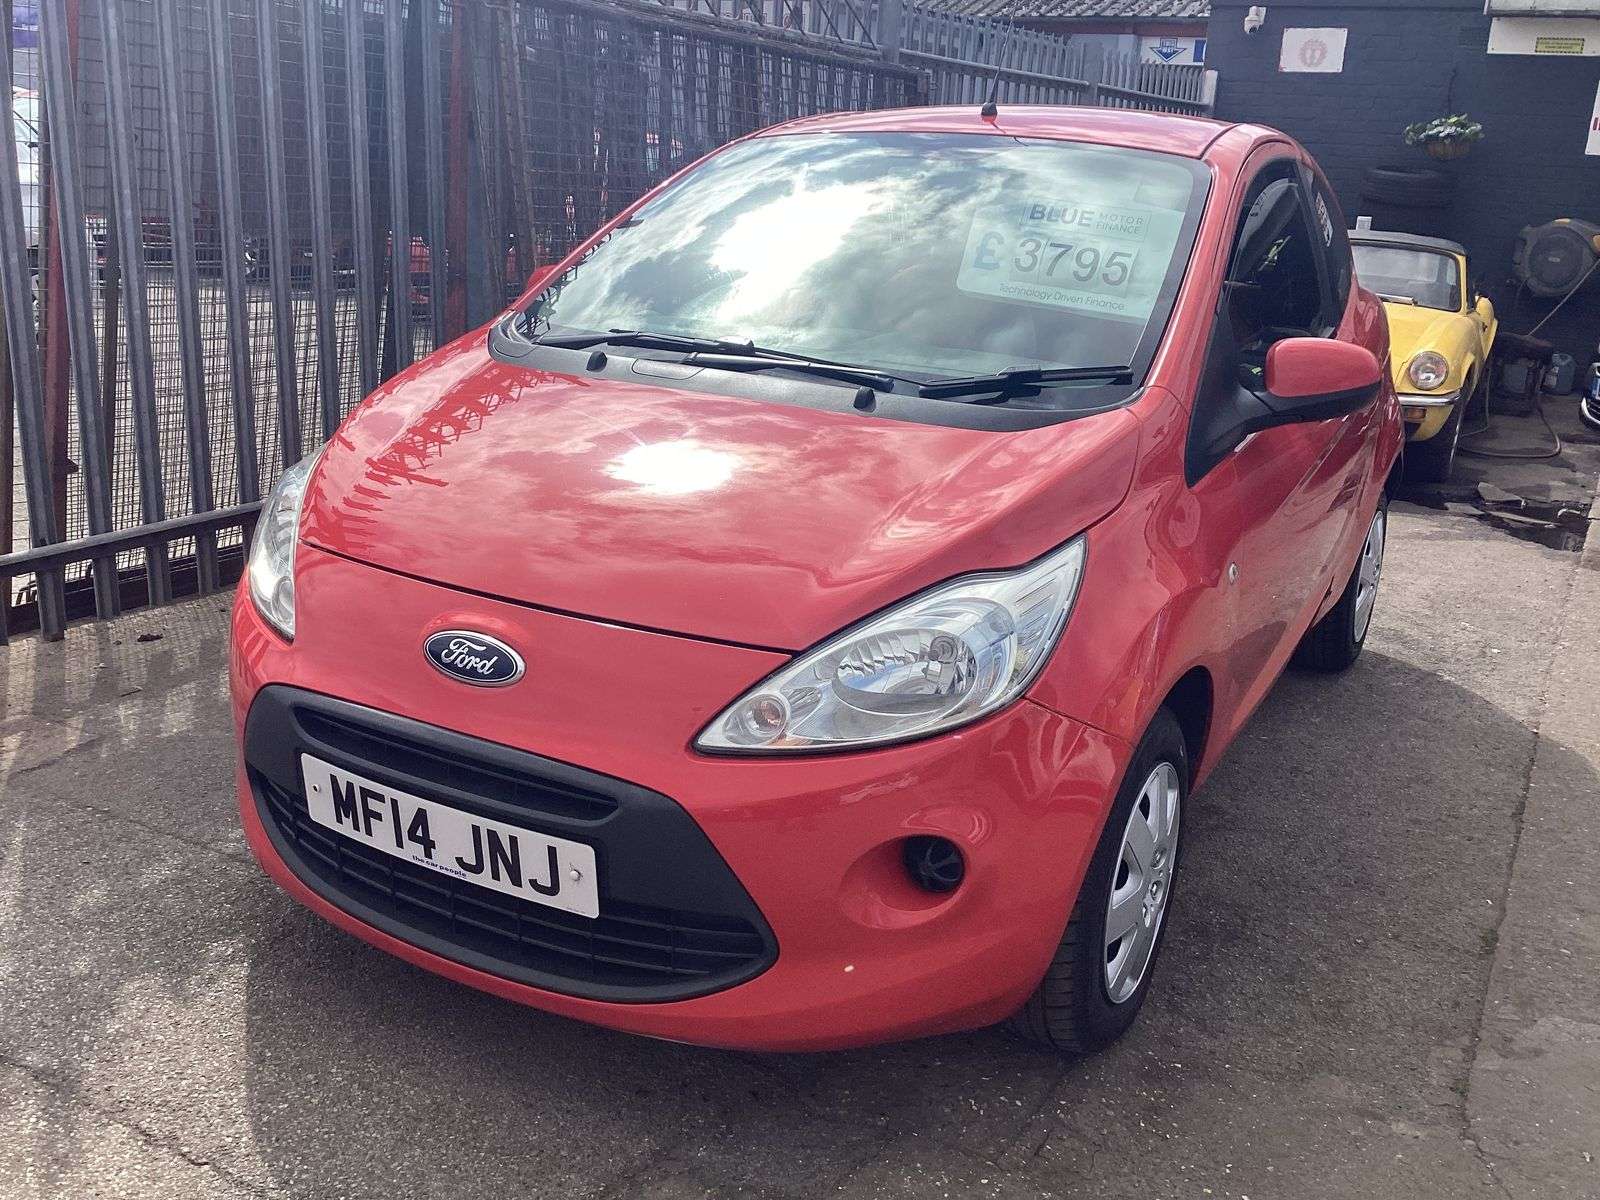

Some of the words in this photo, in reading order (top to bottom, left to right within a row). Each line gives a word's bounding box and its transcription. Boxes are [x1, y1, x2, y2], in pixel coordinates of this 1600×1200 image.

[1029, 203, 1095, 227] BLUE
[1096, 221, 1142, 235] FINANCE
[1099, 212, 1144, 226] MOTOR
[1000, 282, 1052, 301] Technology
[1053, 291, 1084, 305] Driven
[1086, 296, 1125, 311] Finance
[441, 638, 498, 675] Ford
[329, 773, 436, 860] MF14
[455, 824, 561, 897] JNJ
